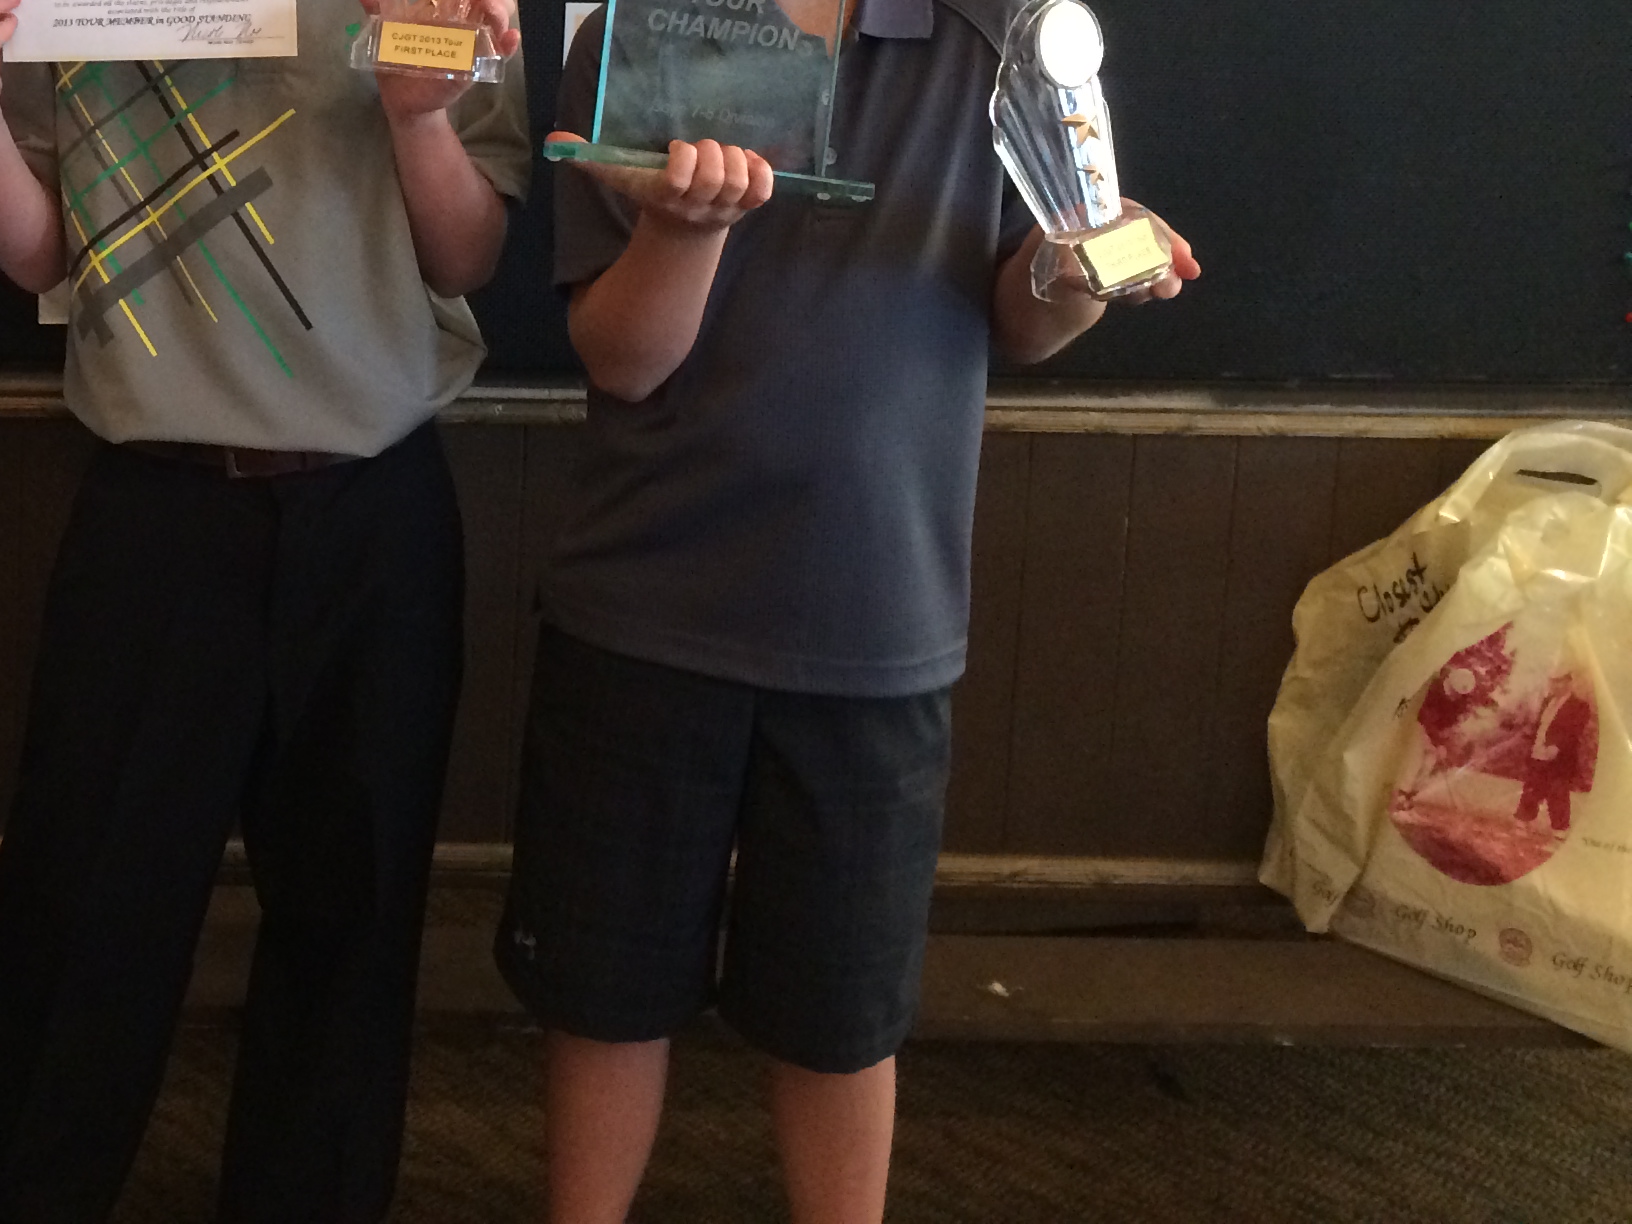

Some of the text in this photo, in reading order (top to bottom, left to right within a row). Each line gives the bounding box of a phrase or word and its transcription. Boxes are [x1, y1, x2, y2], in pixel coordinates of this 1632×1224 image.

[394, 45, 456, 58] FIRST PLACE
[1434, 915, 1477, 945] Shop
